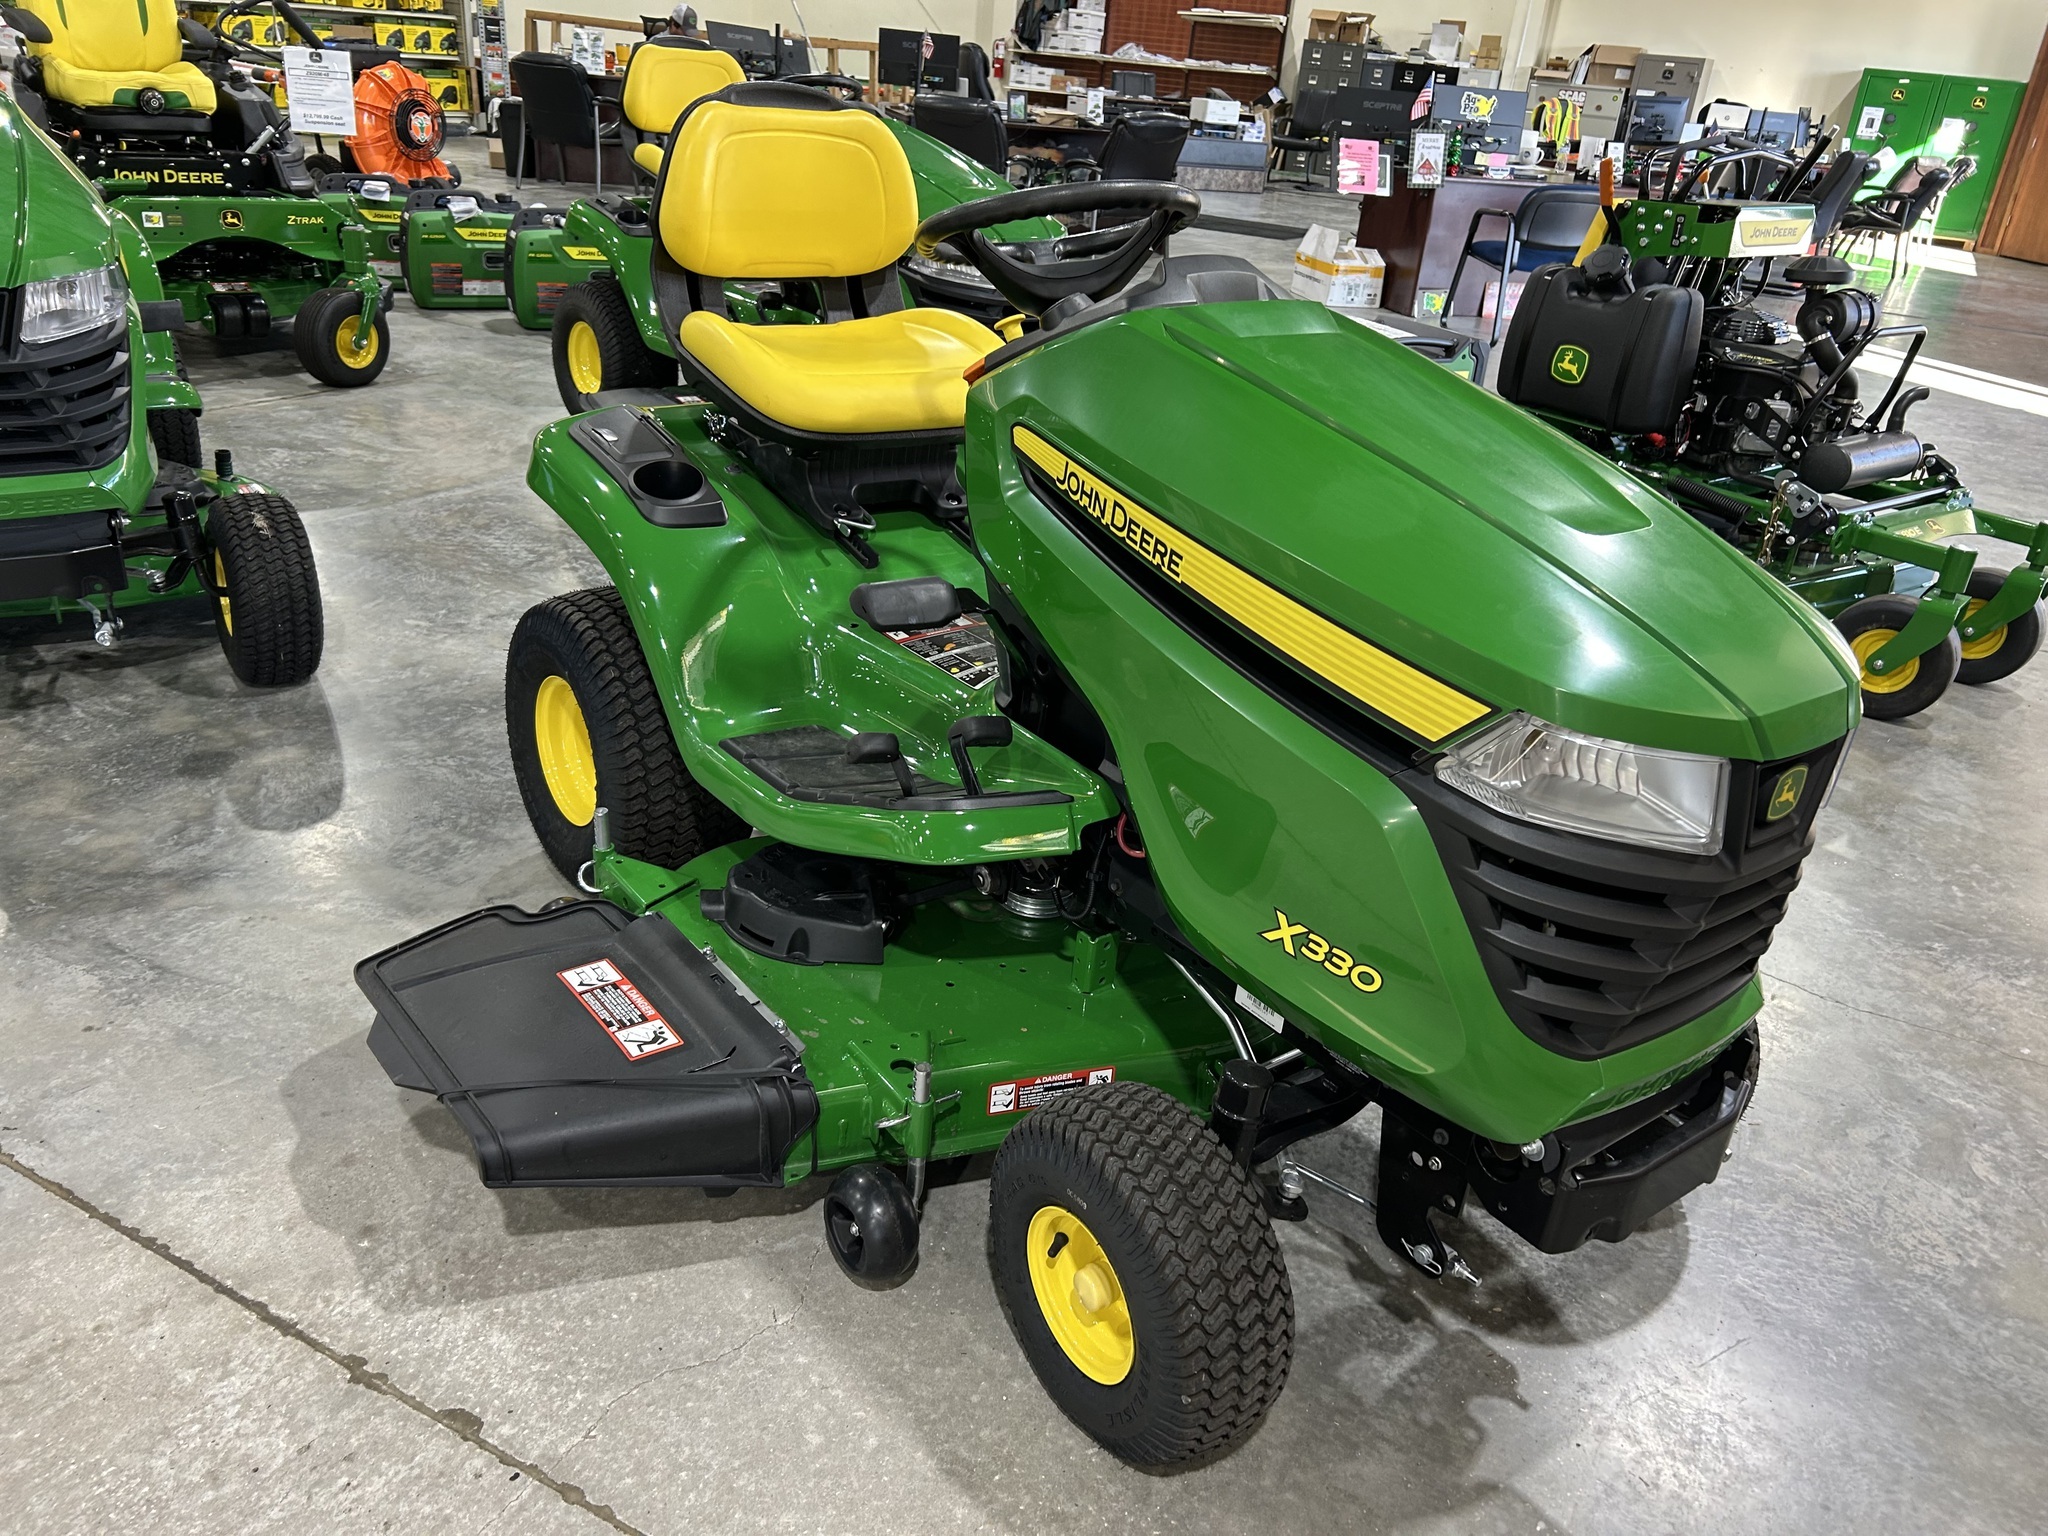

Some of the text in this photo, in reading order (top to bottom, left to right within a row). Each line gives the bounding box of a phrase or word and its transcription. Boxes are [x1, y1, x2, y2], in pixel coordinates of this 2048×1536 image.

[1558, 90, 1587, 102] SCAG
[1363, 101, 1403, 112] SCEPTRE
[1463, 103, 1480, 113] Pro
[113, 168, 225, 184] JOHN DEERE
[287, 215, 324, 225] ZTRAK
[1750, 226, 1798, 239] JOHN DEERE
[1056, 460, 1184, 581] JOHN DEERE
[1257, 906, 1384, 993] X330
[626, 989, 656, 1017] DANGER
[1041, 1073, 1073, 1083] DANGER
